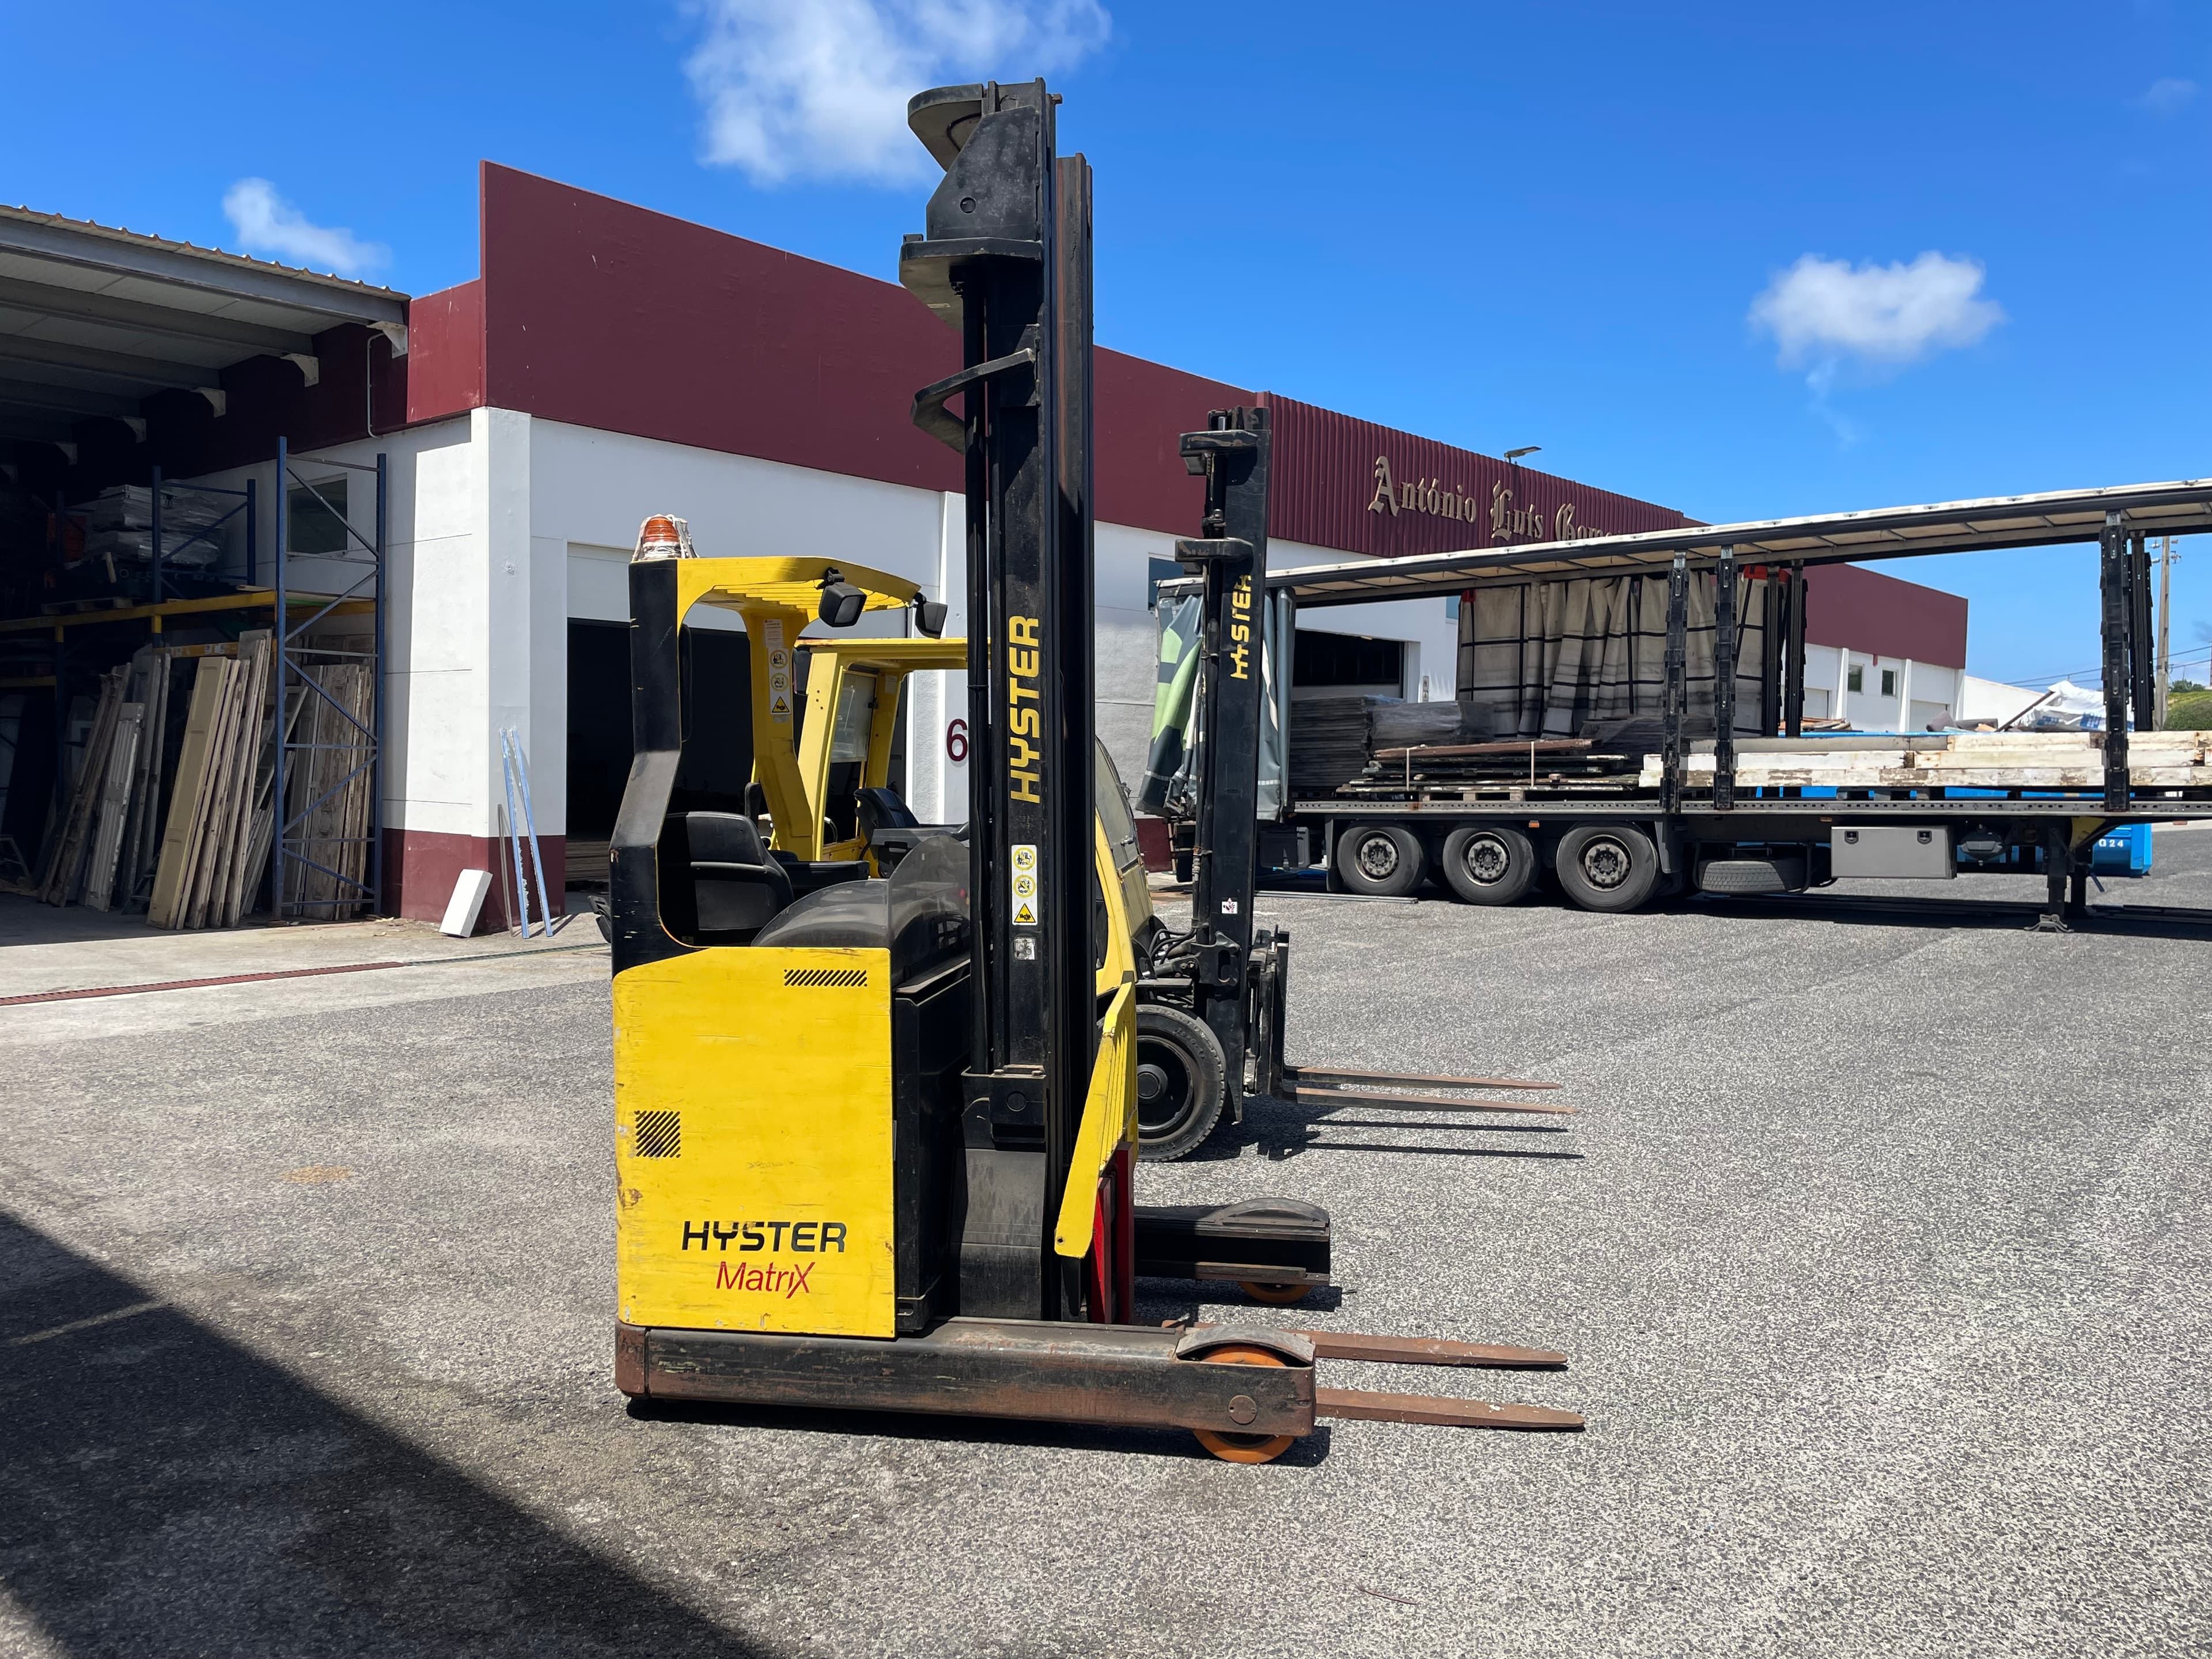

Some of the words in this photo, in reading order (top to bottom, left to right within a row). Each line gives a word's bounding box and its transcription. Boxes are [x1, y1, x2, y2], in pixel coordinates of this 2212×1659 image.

[1368, 456, 1477, 524] António
[1490, 479, 1544, 541] Luís
[1555, 503, 1613, 541] Gom
[1009, 616, 1040, 804] HYSTER
[946, 718, 968, 762] 6
[681, 1221, 847, 1253] HYSTER
[716, 1261, 816, 1299] MatriX
